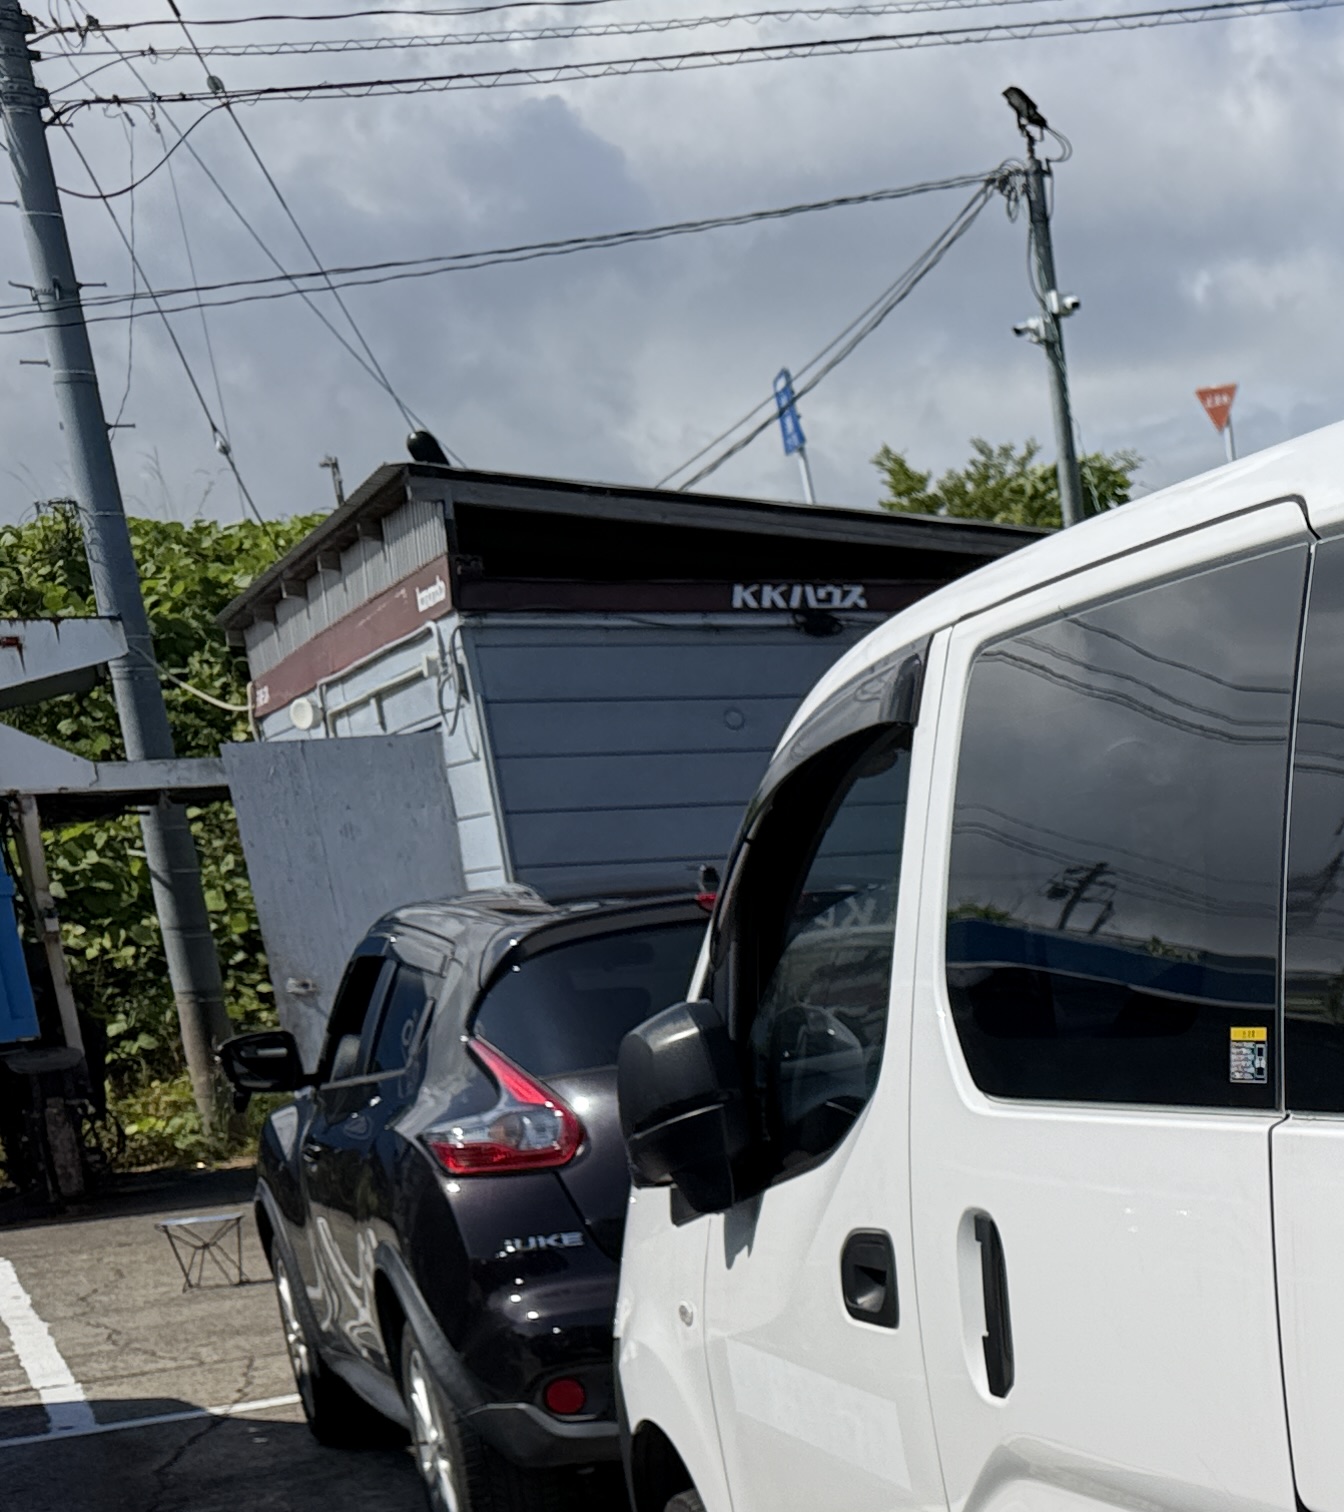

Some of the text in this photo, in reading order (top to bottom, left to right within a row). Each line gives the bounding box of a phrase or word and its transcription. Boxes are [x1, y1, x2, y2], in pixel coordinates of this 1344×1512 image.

[732, 583, 868, 609] KKハウス
[497, 1231, 586, 1258] JUKE
